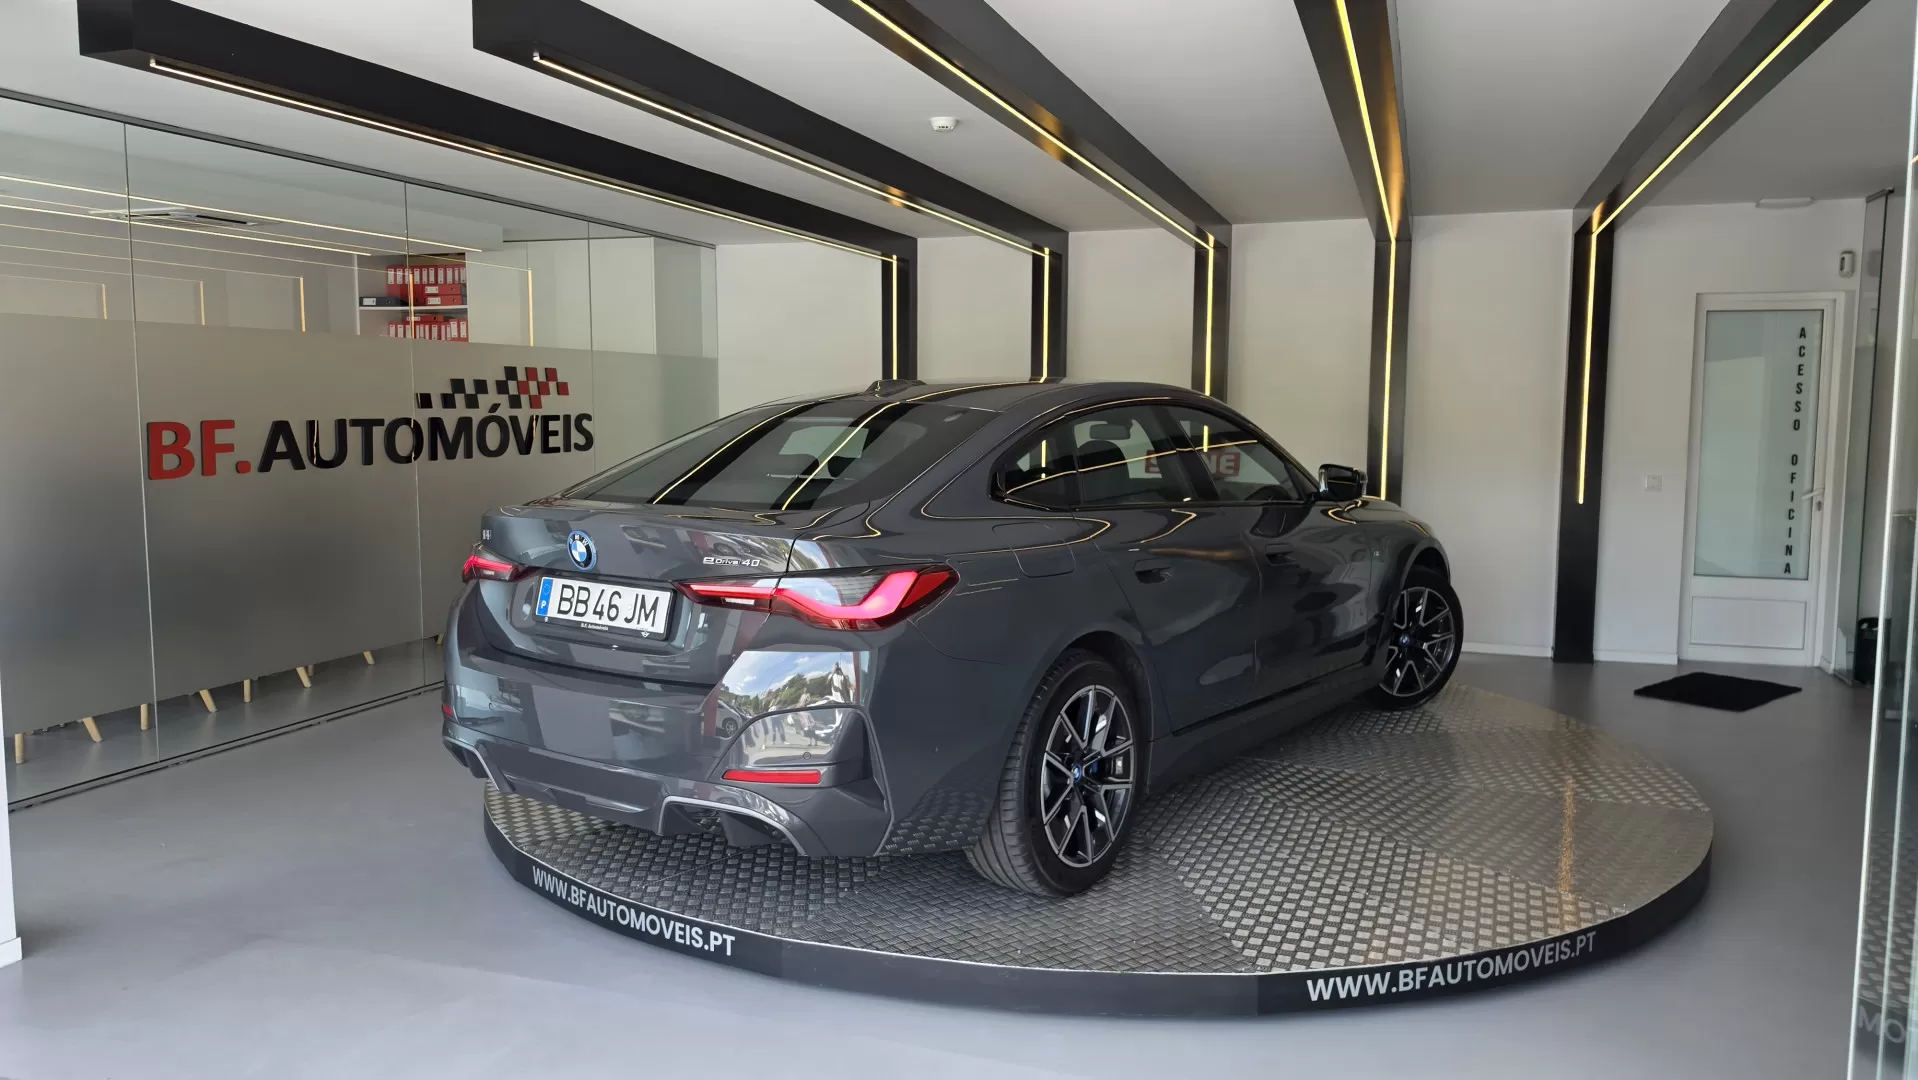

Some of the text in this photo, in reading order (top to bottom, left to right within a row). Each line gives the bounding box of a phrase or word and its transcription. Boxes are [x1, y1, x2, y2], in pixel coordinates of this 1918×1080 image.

[1783, 326, 1807, 575] ACESSO OFICINA
[532, 865, 736, 956] WWW.BFAUTOMOVEIS.PT
[1306, 931, 1597, 1002] WWW.BFAUTOMOVEIS.PT
